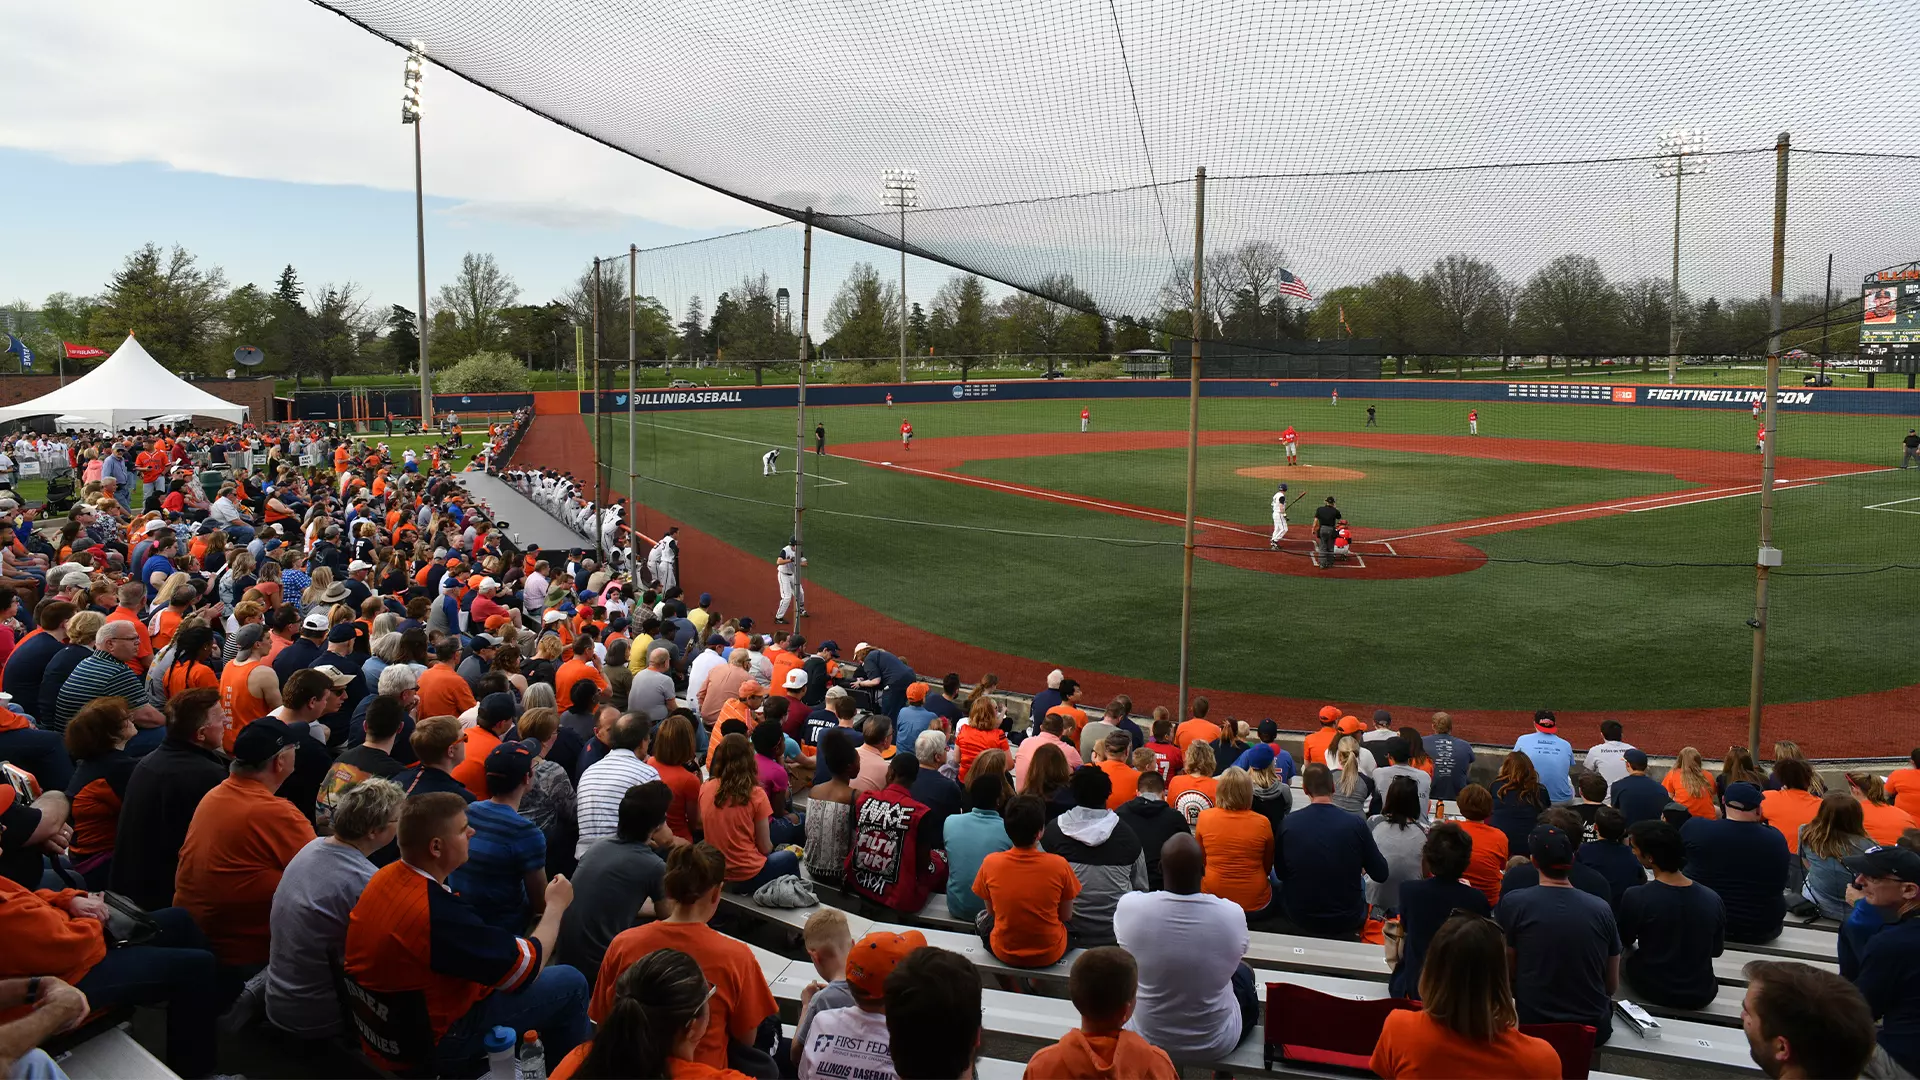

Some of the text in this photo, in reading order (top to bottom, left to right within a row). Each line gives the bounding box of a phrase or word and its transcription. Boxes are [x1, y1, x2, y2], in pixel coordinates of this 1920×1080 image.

[1647, 389, 1813, 404] FIGHTINGILLINICOM
[857, 833, 897, 855] FILTH
[856, 851, 892, 871] FURY
[835, 1035, 864, 1051] FIRST
[817, 1061, 852, 1077] ILLINOIS
